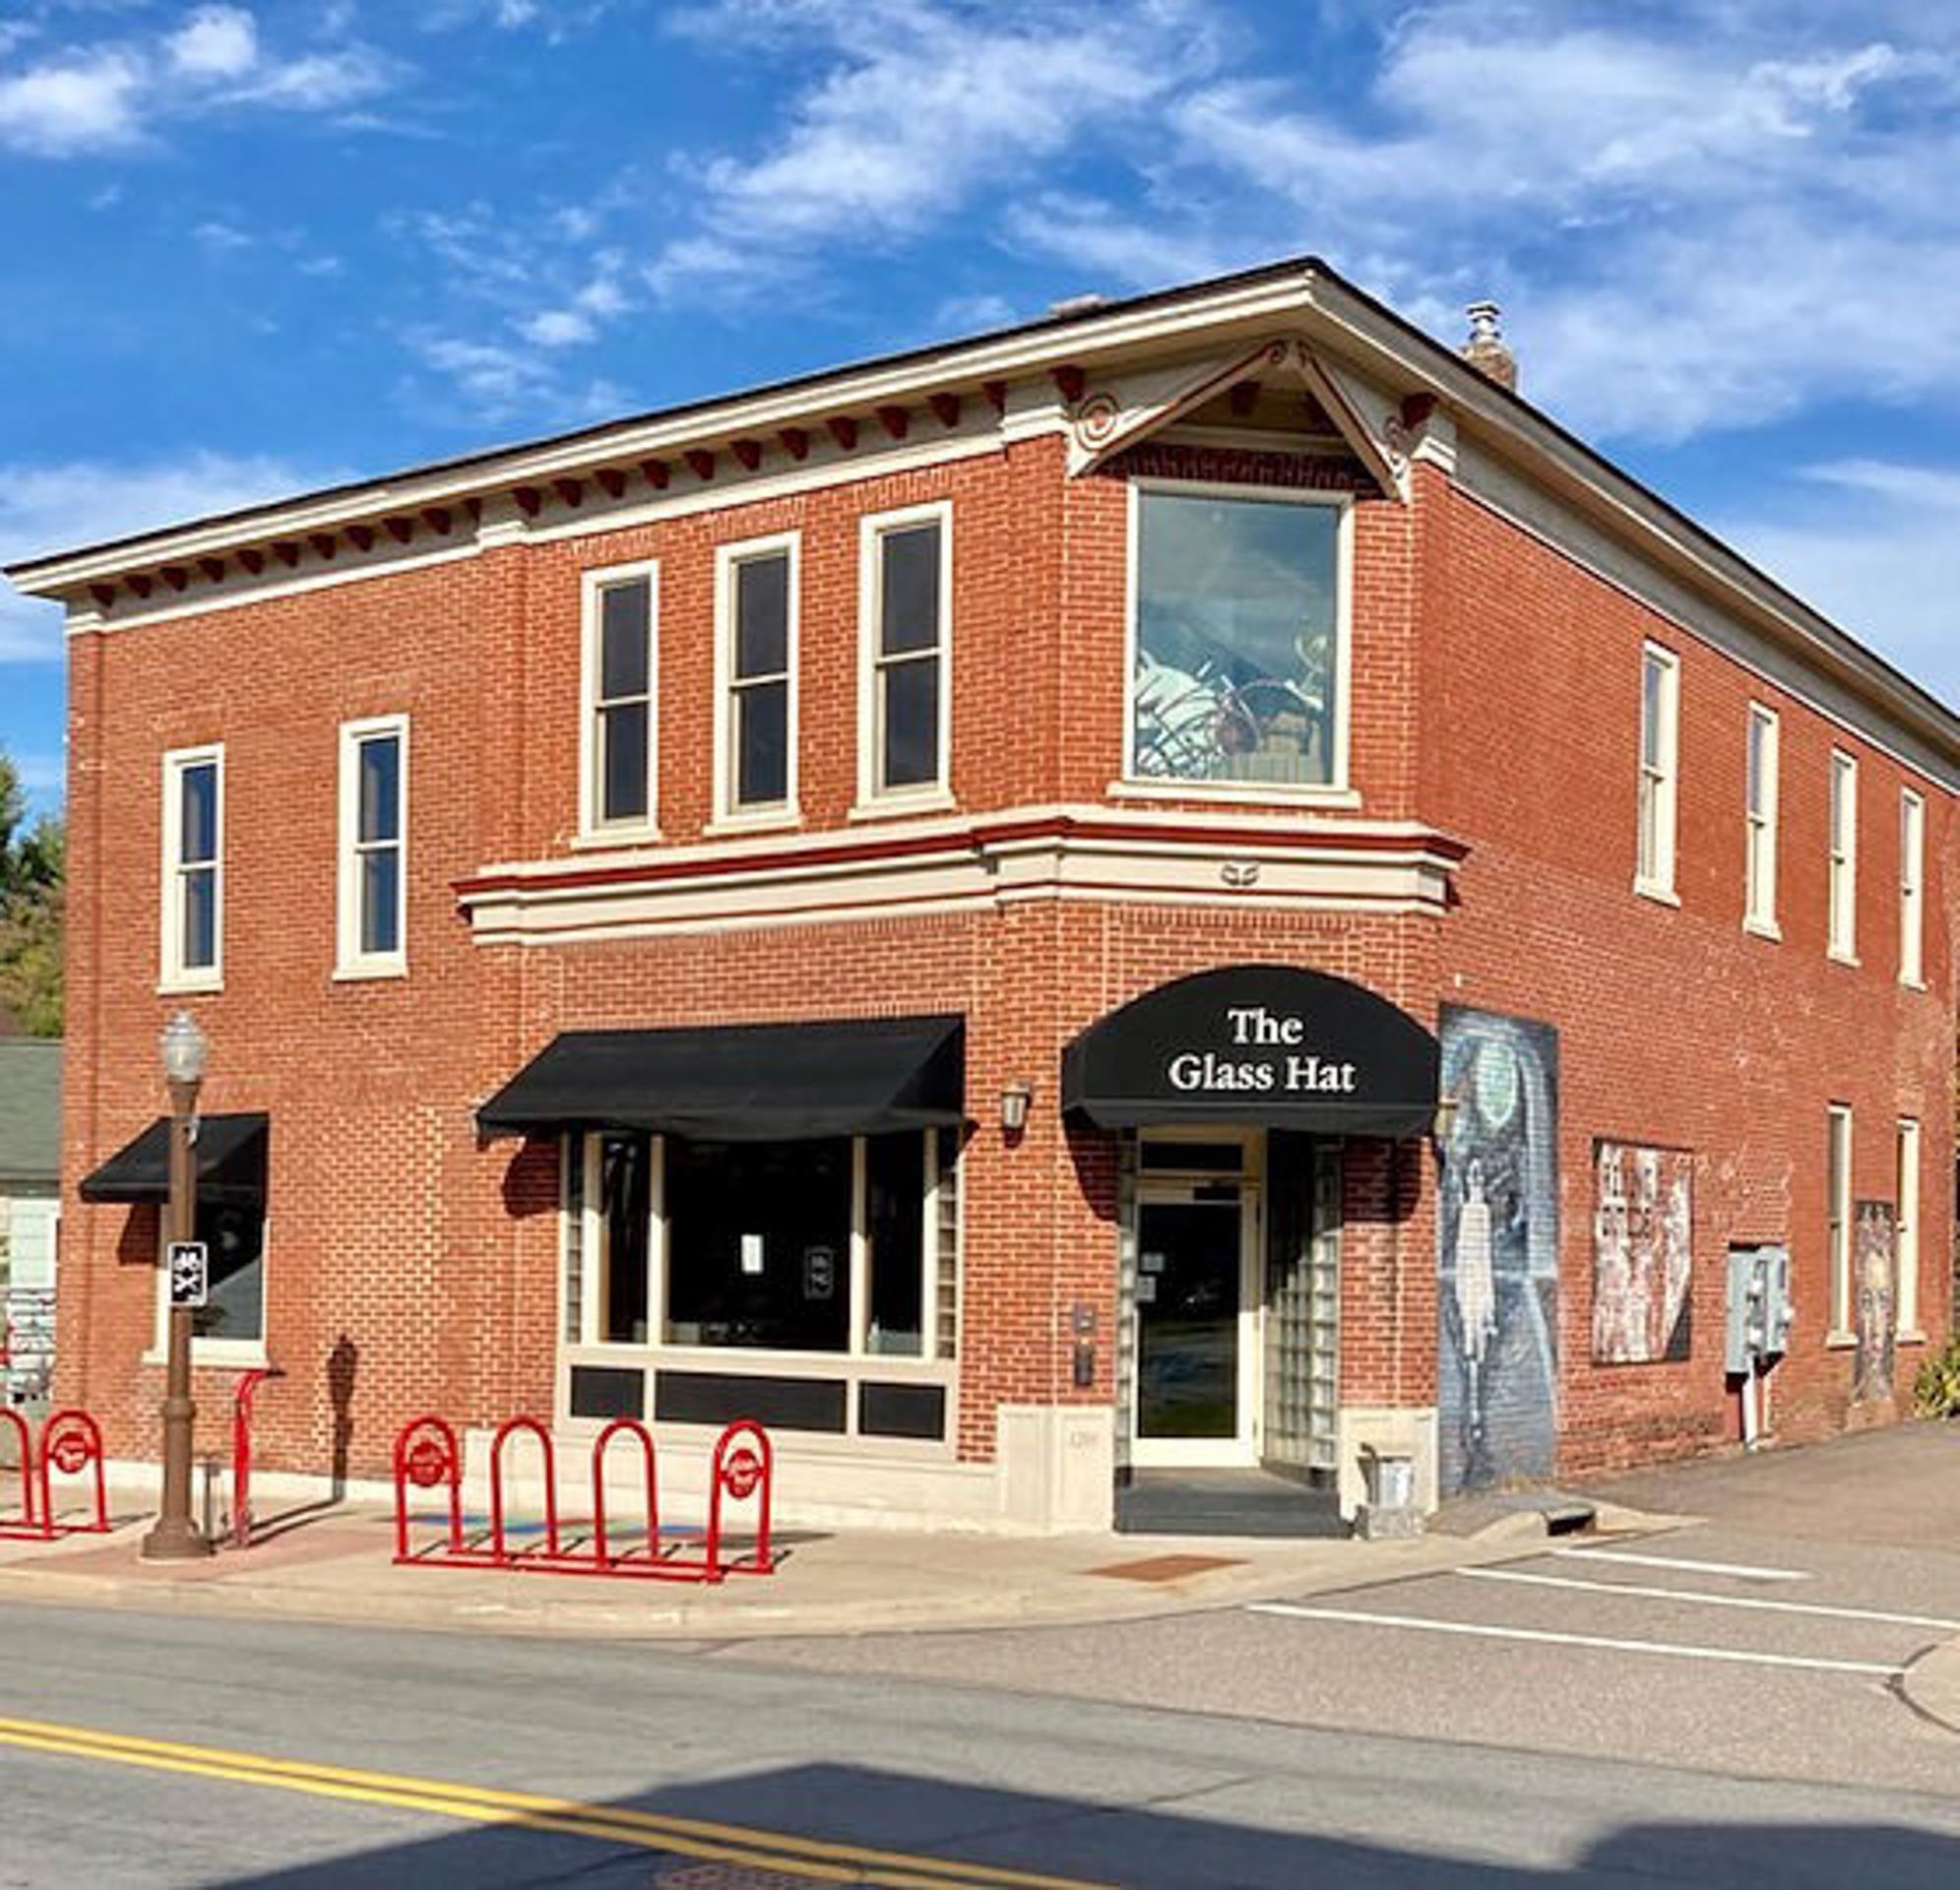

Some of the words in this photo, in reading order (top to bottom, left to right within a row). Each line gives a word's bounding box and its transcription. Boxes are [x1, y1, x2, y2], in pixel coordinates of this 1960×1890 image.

[1228, 1007, 1303, 1044] The
[1169, 1053, 1275, 1091] Glass
[1285, 1056, 1357, 1092] Hat
